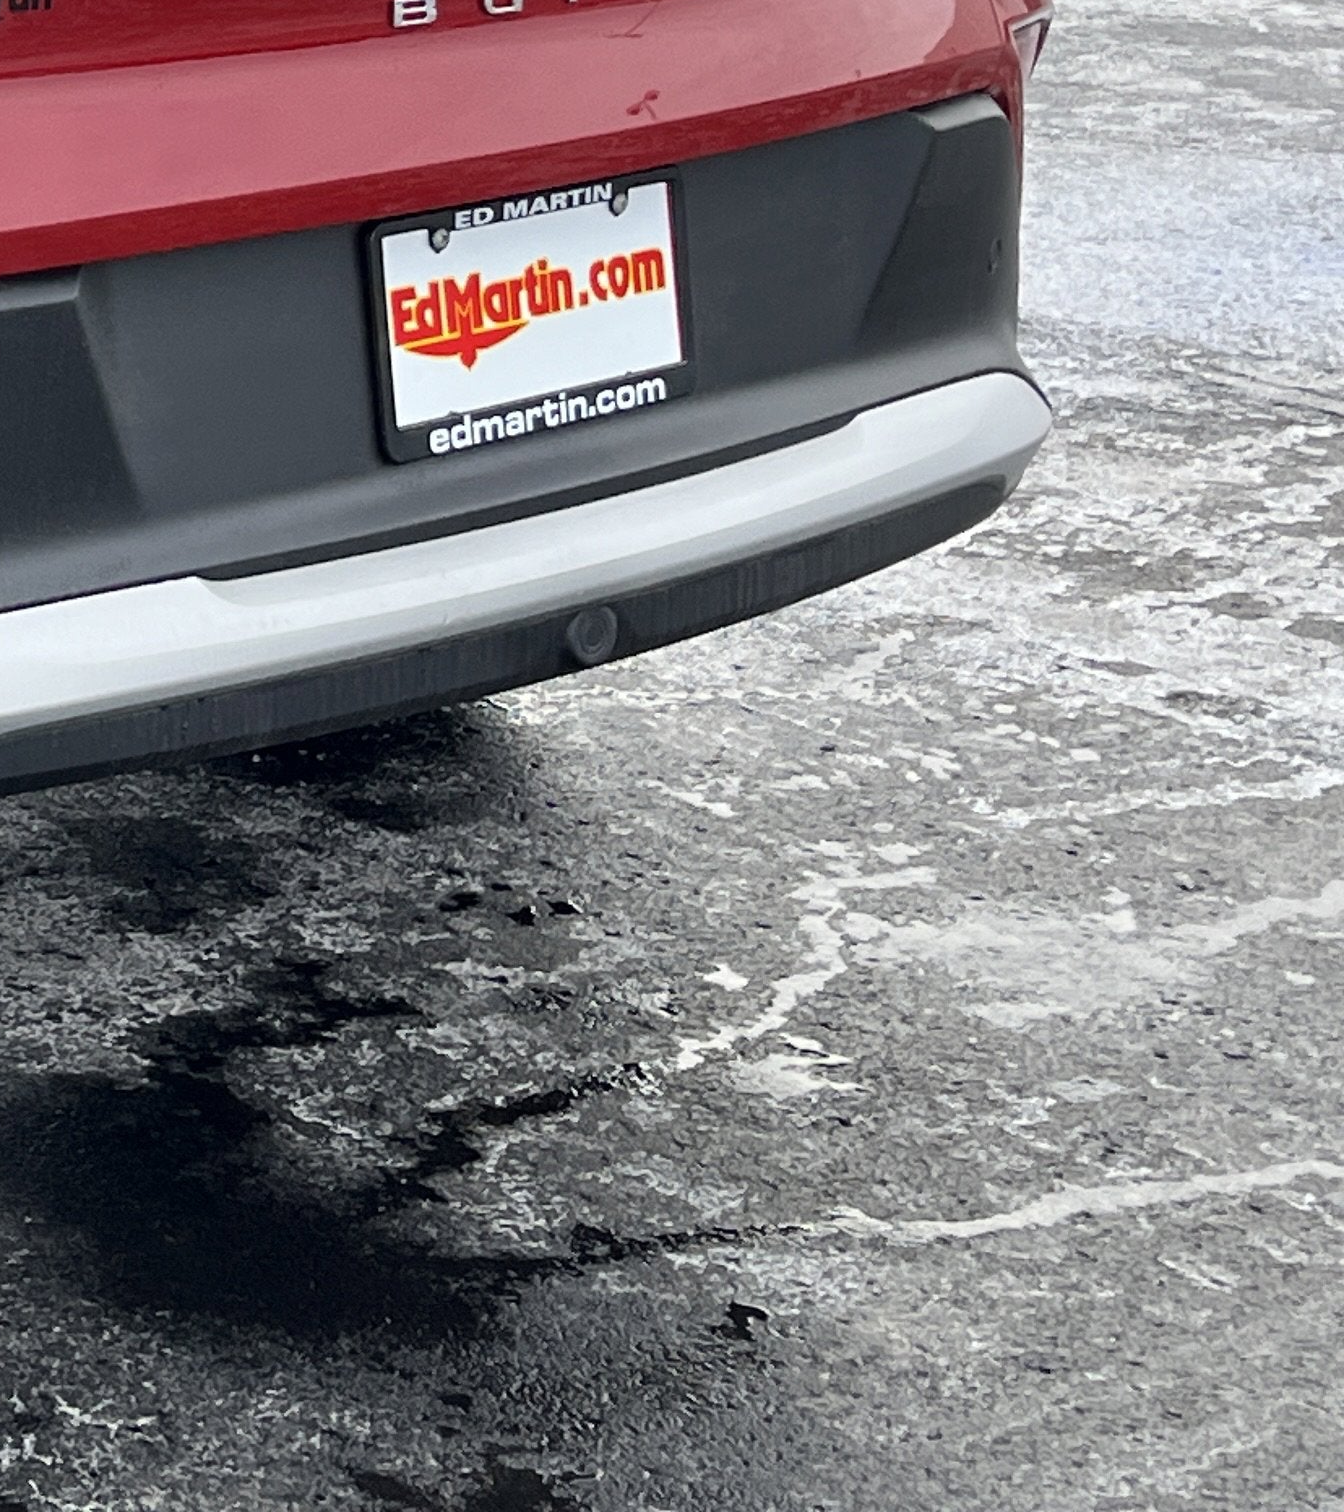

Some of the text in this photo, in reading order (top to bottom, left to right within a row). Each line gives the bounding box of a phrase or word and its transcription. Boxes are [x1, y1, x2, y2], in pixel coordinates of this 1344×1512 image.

[454, 182, 613, 231] ED MARTIN
[390, 248, 666, 348] EdMartin.com
[428, 376, 667, 455] edmartin.com
